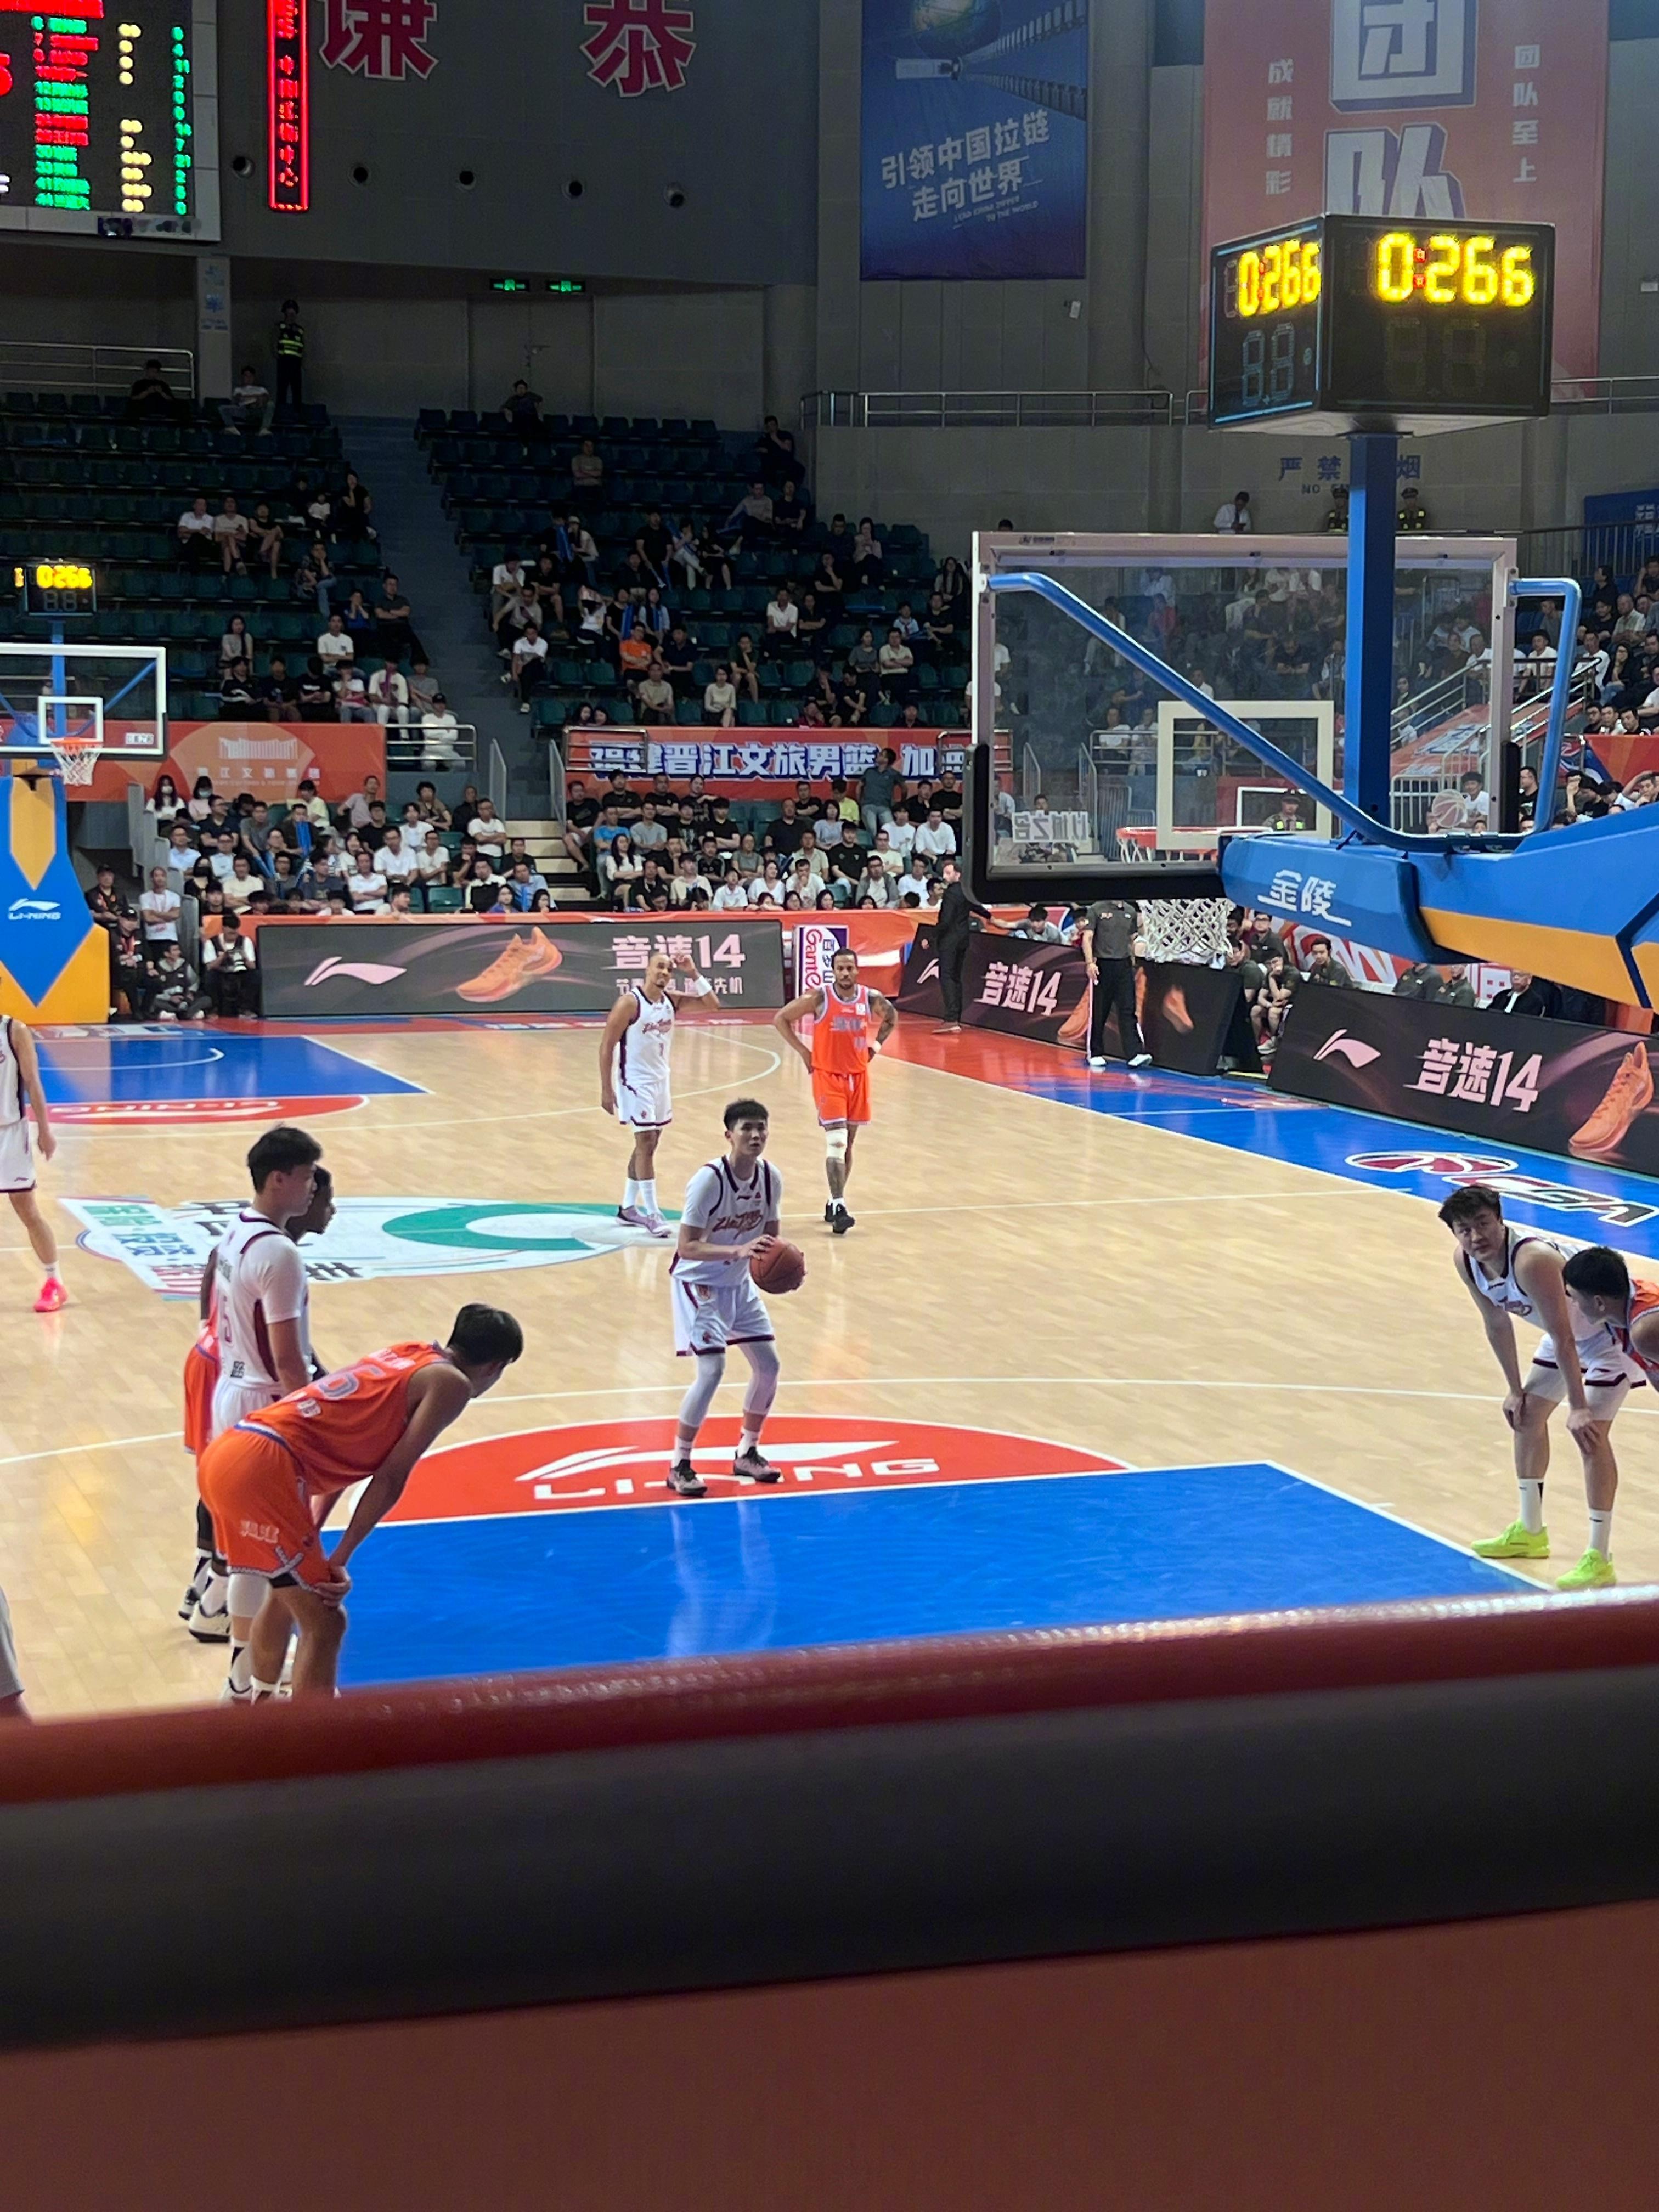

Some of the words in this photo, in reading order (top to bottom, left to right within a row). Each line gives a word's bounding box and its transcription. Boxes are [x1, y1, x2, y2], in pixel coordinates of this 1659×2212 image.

[882, 109, 1049, 189] 引领中国拉链
[912, 157, 1028, 222] 走向世界
[1012, 200, 1039, 213] WORLD
[1279, 454, 1421, 481] 严禁烟
[1258, 868, 1352, 927] 金陵
[805, 928, 822, 991] Gante
[974, 961, 1062, 1016] 音速14
[1403, 1037, 1543, 1113] 音速14
